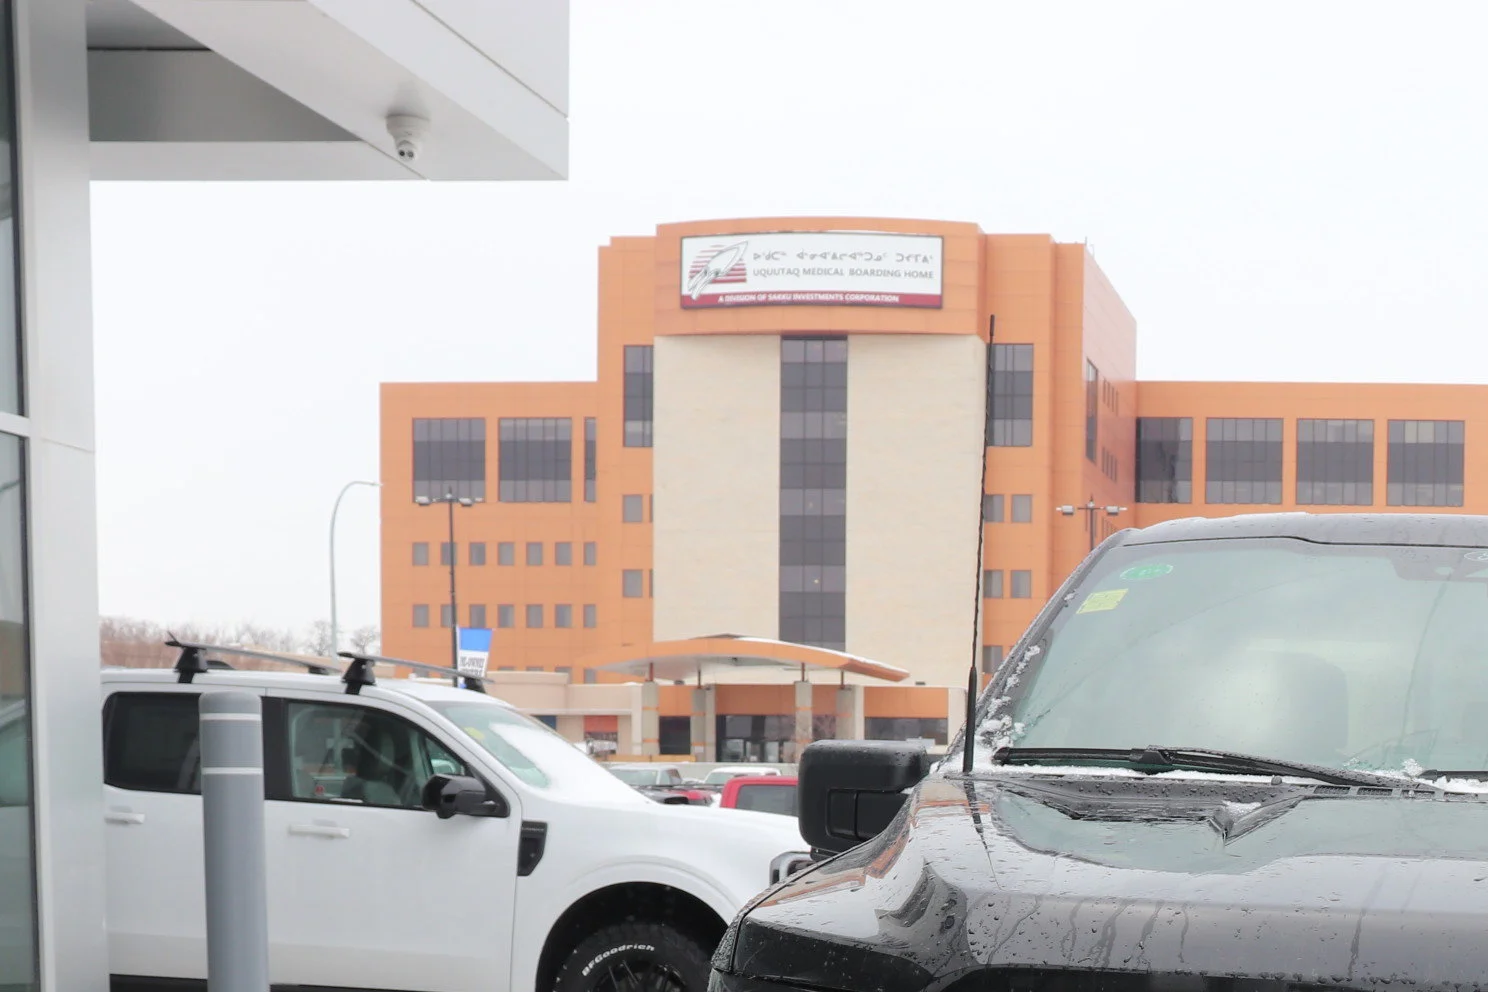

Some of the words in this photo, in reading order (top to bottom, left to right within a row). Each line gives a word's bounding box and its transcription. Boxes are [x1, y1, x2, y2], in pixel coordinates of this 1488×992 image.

[753, 267, 801, 278] UQUUTAQ
[802, 267, 844, 276] MEDICAL
[848, 267, 902, 278] BOARDING
[903, 269, 935, 279] HOME
[844, 293, 900, 303] CORPORATION
[581, 943, 655, 976] BFGoodrich
